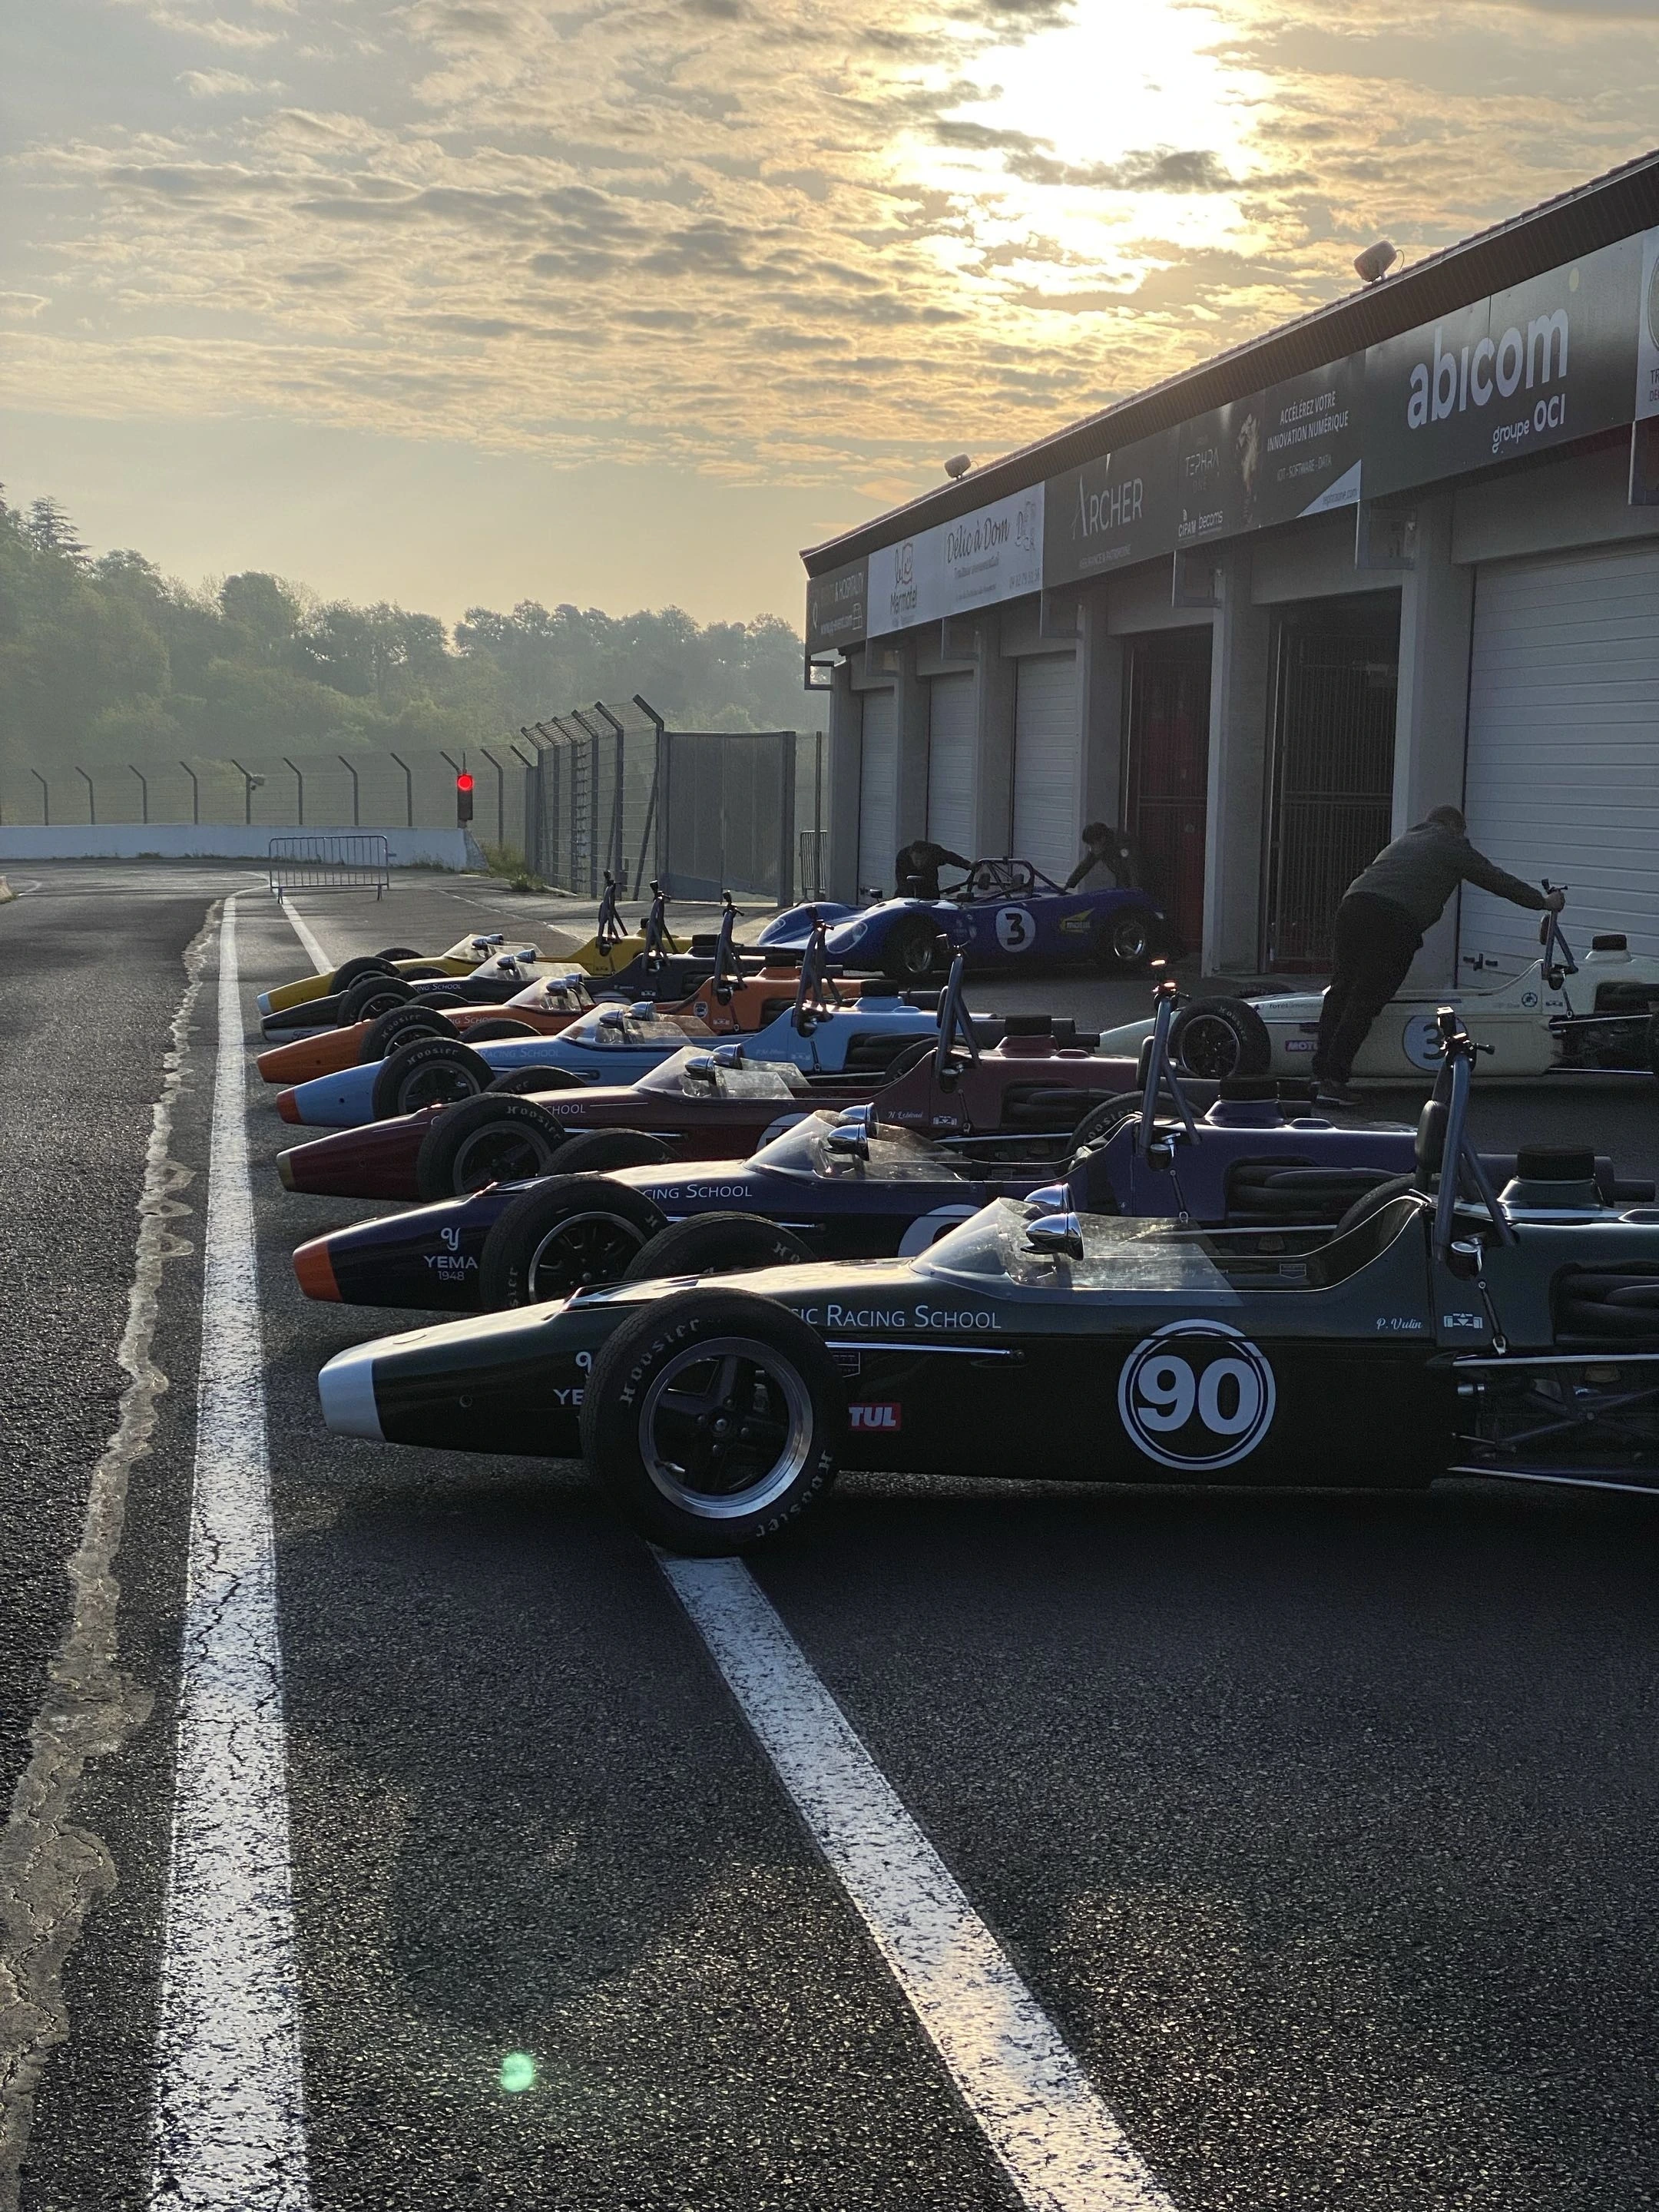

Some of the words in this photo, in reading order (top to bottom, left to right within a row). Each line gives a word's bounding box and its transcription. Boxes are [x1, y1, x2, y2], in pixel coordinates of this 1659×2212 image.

[1407, 309, 1569, 429] abicom
[1280, 399, 1314, 426] ACCÉLÉREZ
[1315, 390, 1336, 413] VOTRE
[1267, 424, 1308, 452] INNOVATION
[1308, 410, 1349, 438] NUMÉRIQUE
[1492, 419, 1530, 453] groupe
[1534, 393, 1565, 432] OCI
[1071, 473, 1143, 540] ARCHER
[1005, 912, 1026, 945] 3
[520, 1047, 560, 1058] SCHOOL
[643, 1187, 680, 1200] CING
[686, 1184, 753, 1199] SCHOOL
[423, 1255, 478, 1269] YEMA
[437, 1270, 465, 1281] 1948
[826, 1304, 906, 1328] RACING
[915, 1304, 1002, 1330] SCHOOL
[553, 1389, 584, 1406] YE
[1137, 1355, 1260, 1435] 90
[848, 1407, 897, 1427] TUL
